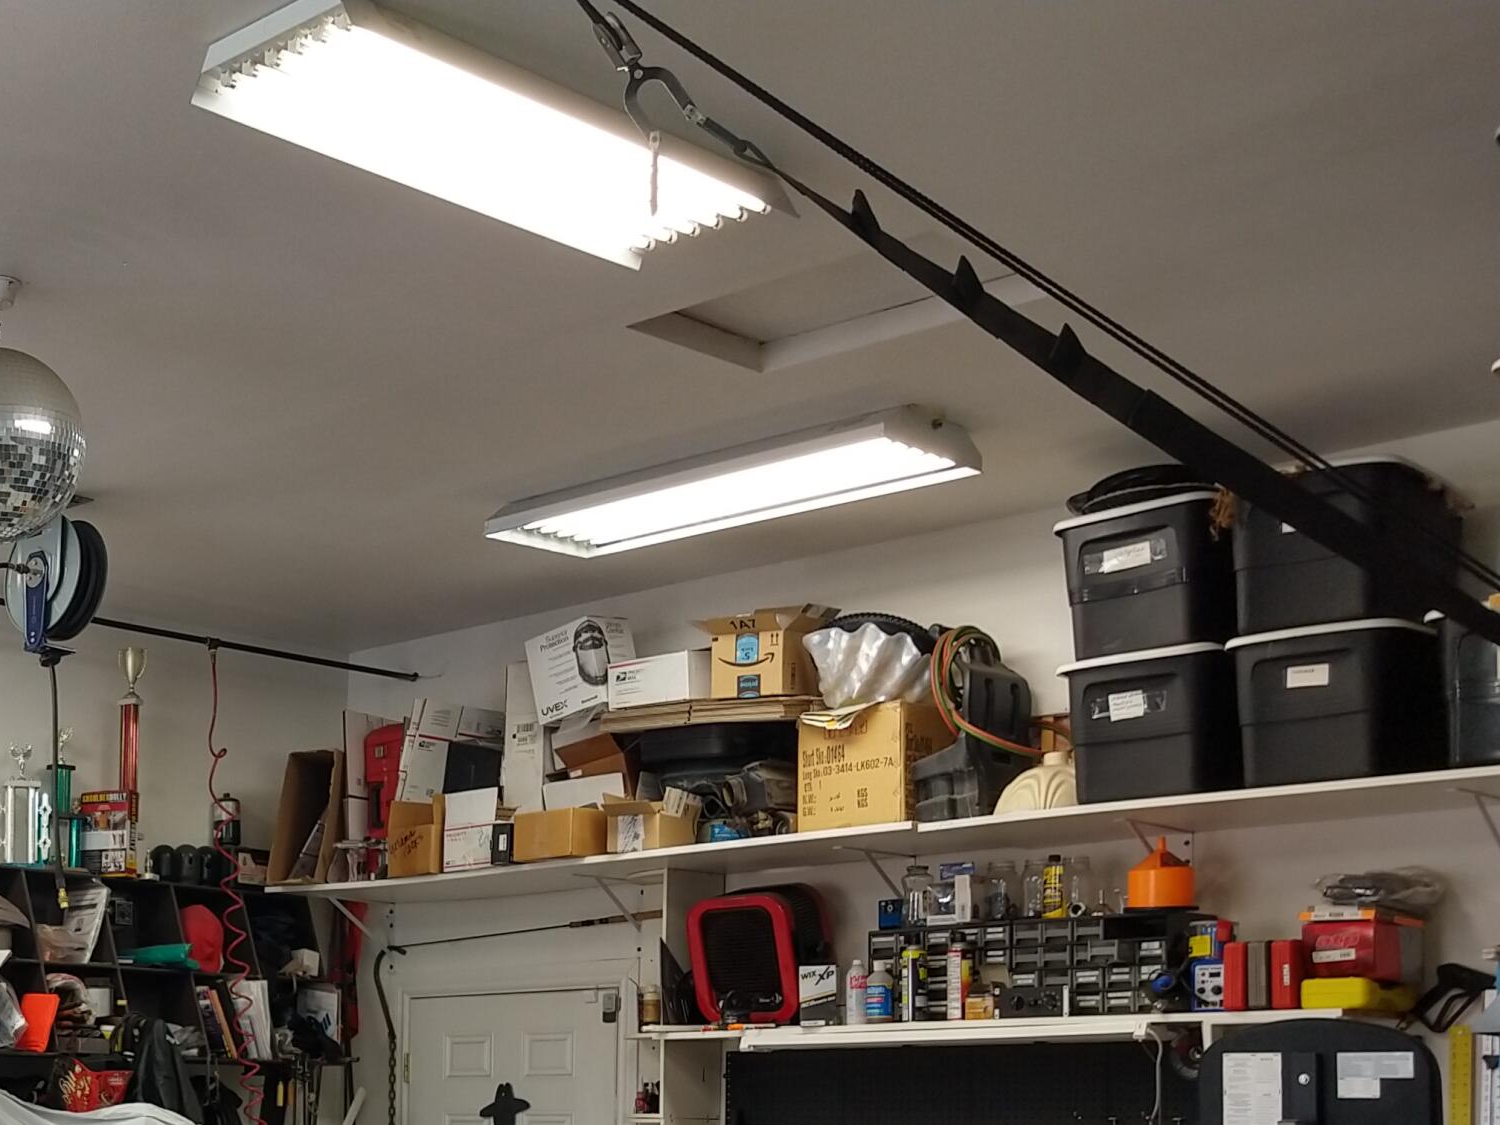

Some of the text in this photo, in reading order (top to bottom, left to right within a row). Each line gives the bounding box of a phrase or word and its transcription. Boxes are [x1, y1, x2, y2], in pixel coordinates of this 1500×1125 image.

[541, 699, 569, 717] UVEX
[800, 970, 817, 981] WIX
[815, 965, 835, 986] XP
